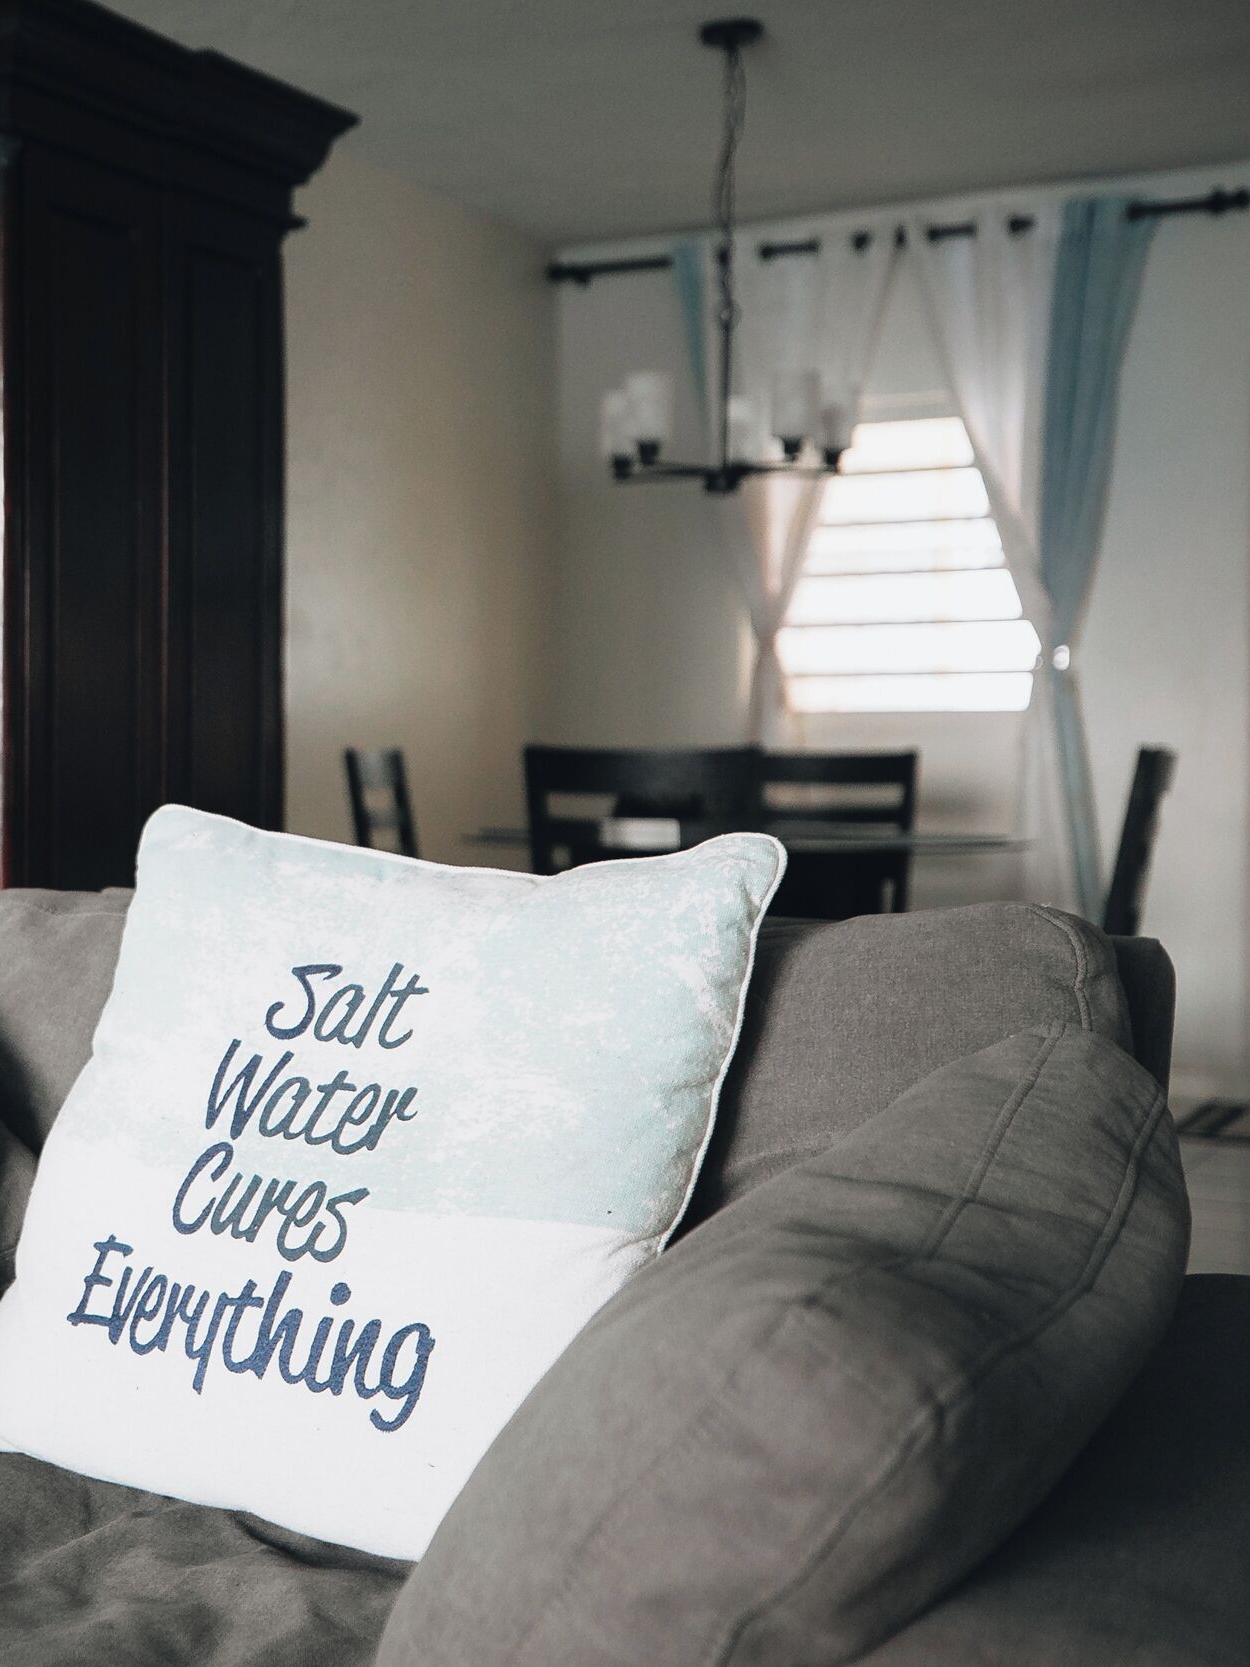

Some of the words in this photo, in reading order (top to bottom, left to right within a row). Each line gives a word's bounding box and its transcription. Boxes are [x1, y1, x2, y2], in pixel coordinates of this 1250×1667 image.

[264, 962, 430, 1050] Salt
[205, 1038, 418, 1156] Water
[172, 1141, 370, 1264] Cures
[66, 1234, 436, 1433] Everything
